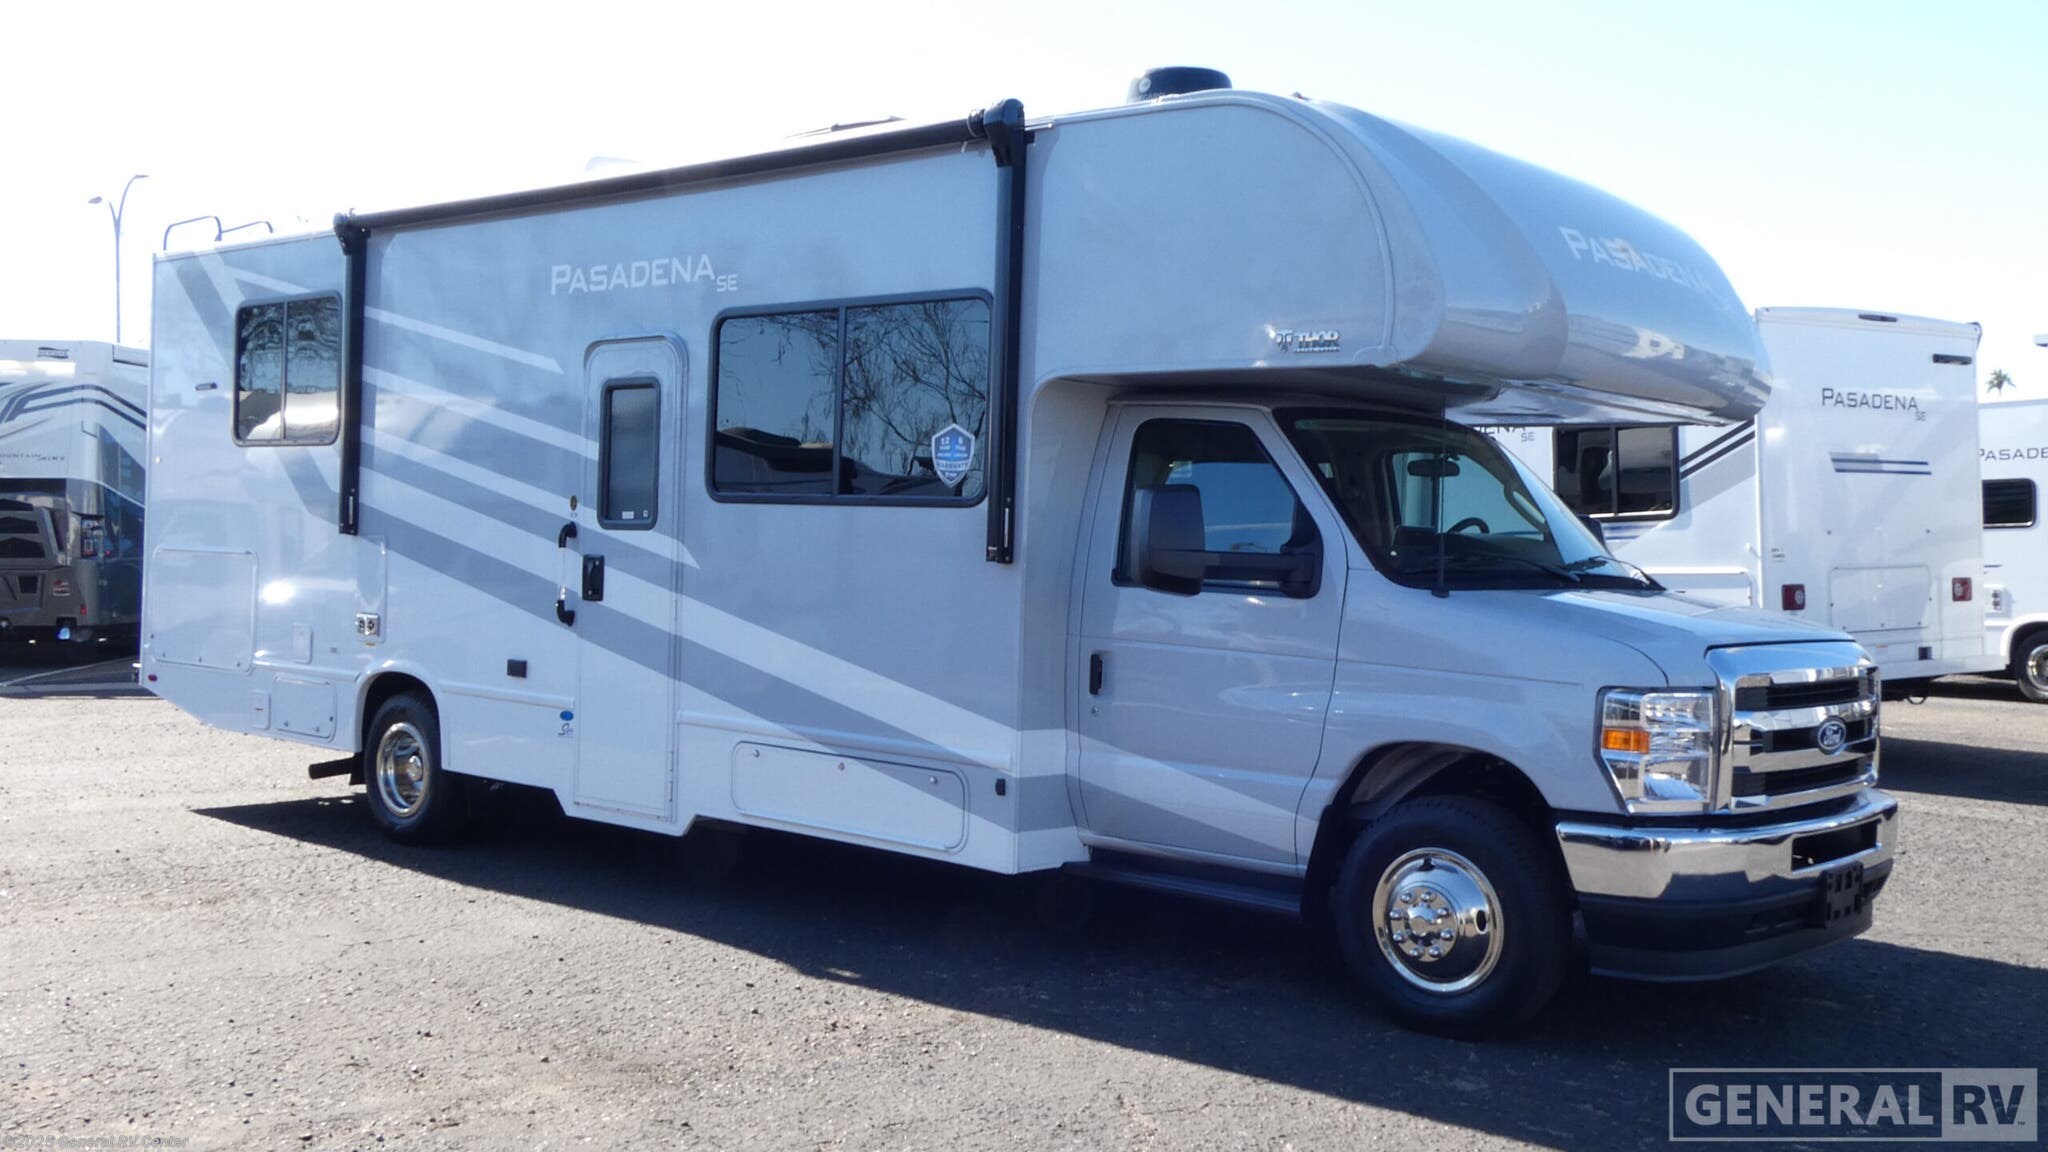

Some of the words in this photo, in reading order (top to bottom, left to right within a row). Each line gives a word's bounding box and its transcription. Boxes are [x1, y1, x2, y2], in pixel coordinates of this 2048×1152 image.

[551, 253, 715, 296] PASADENA
[716, 273, 737, 292] SE
[1821, 387, 1918, 411] PASADENA
[1520, 431, 1535, 442] SE
[1823, 725, 1842, 746] Ford
